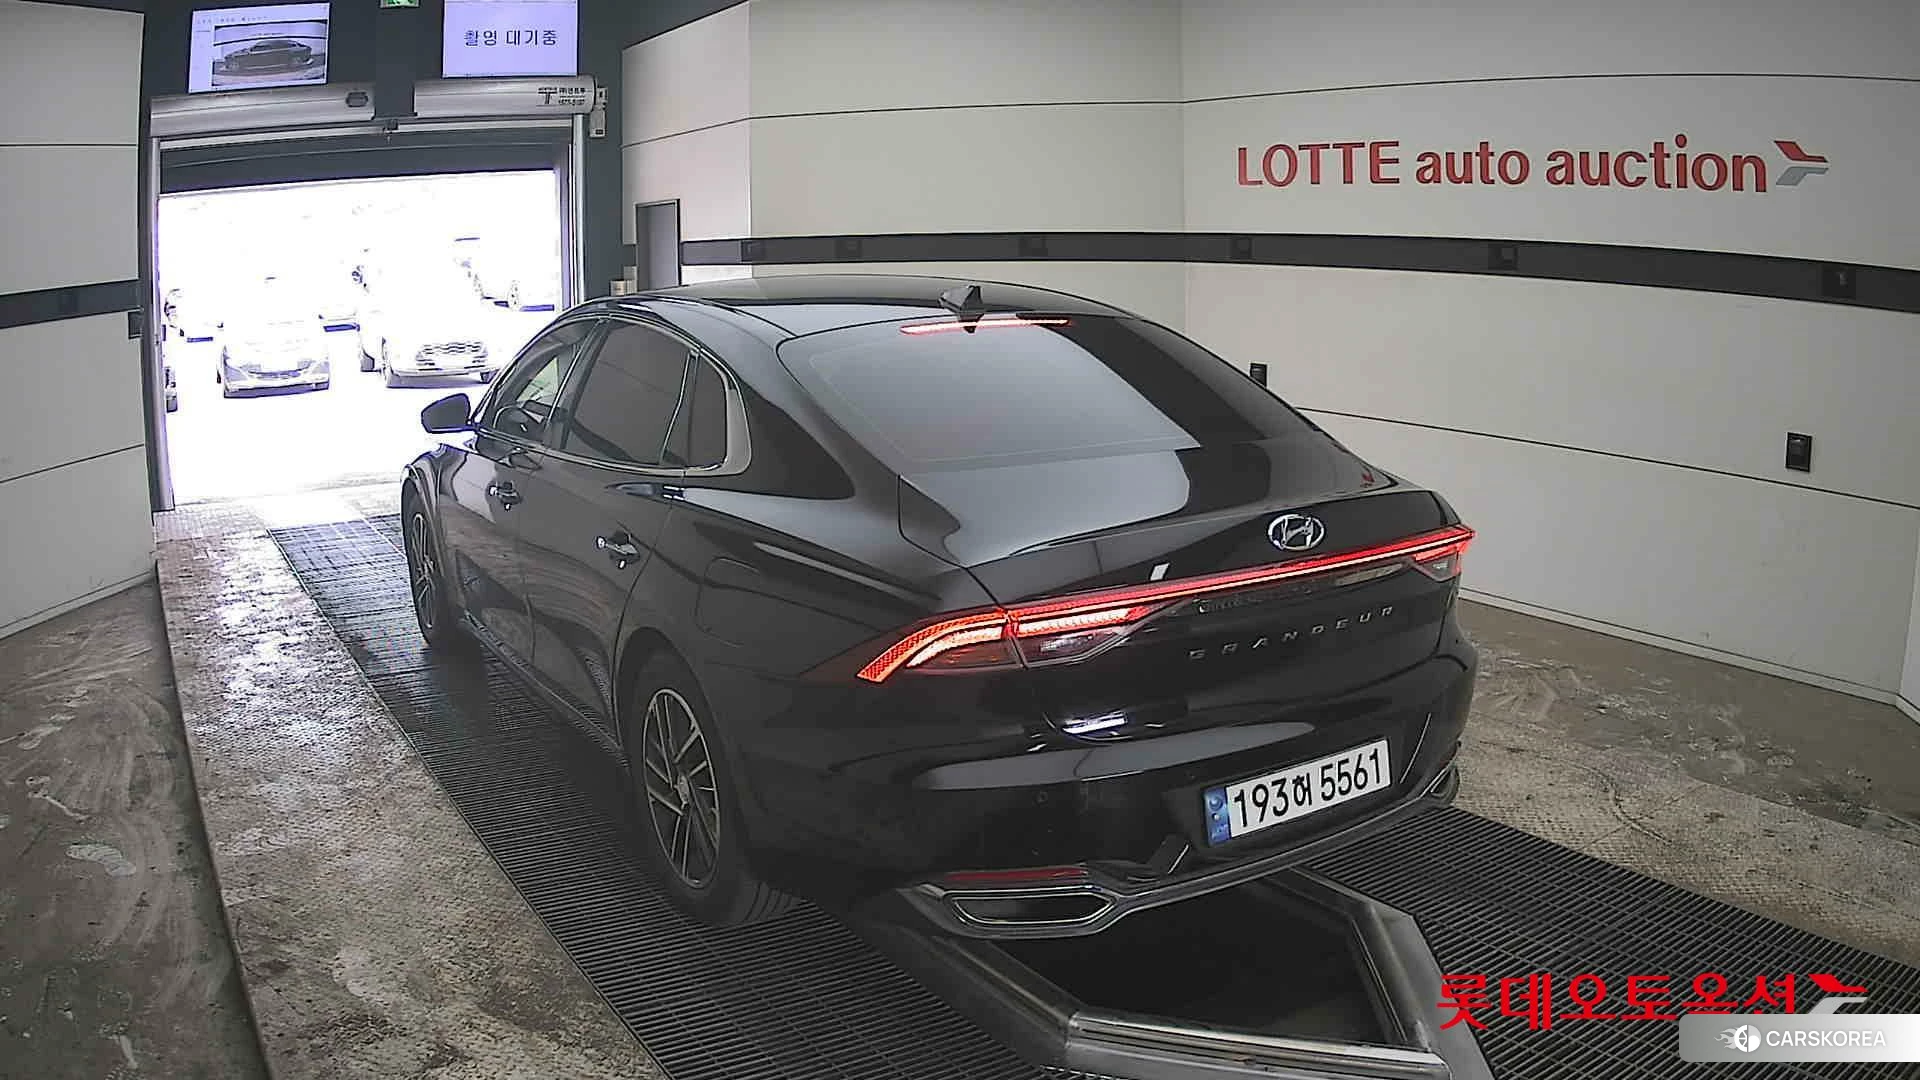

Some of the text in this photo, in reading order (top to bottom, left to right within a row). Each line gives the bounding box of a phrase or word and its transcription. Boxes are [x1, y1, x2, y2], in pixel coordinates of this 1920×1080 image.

[505, 29, 558, 46] 대기중
[1237, 133, 1767, 193] LOTTE auto auction
[1188, 606, 1393, 660] GRANDEUR
[1233, 748, 1380, 828] 193허 5561
